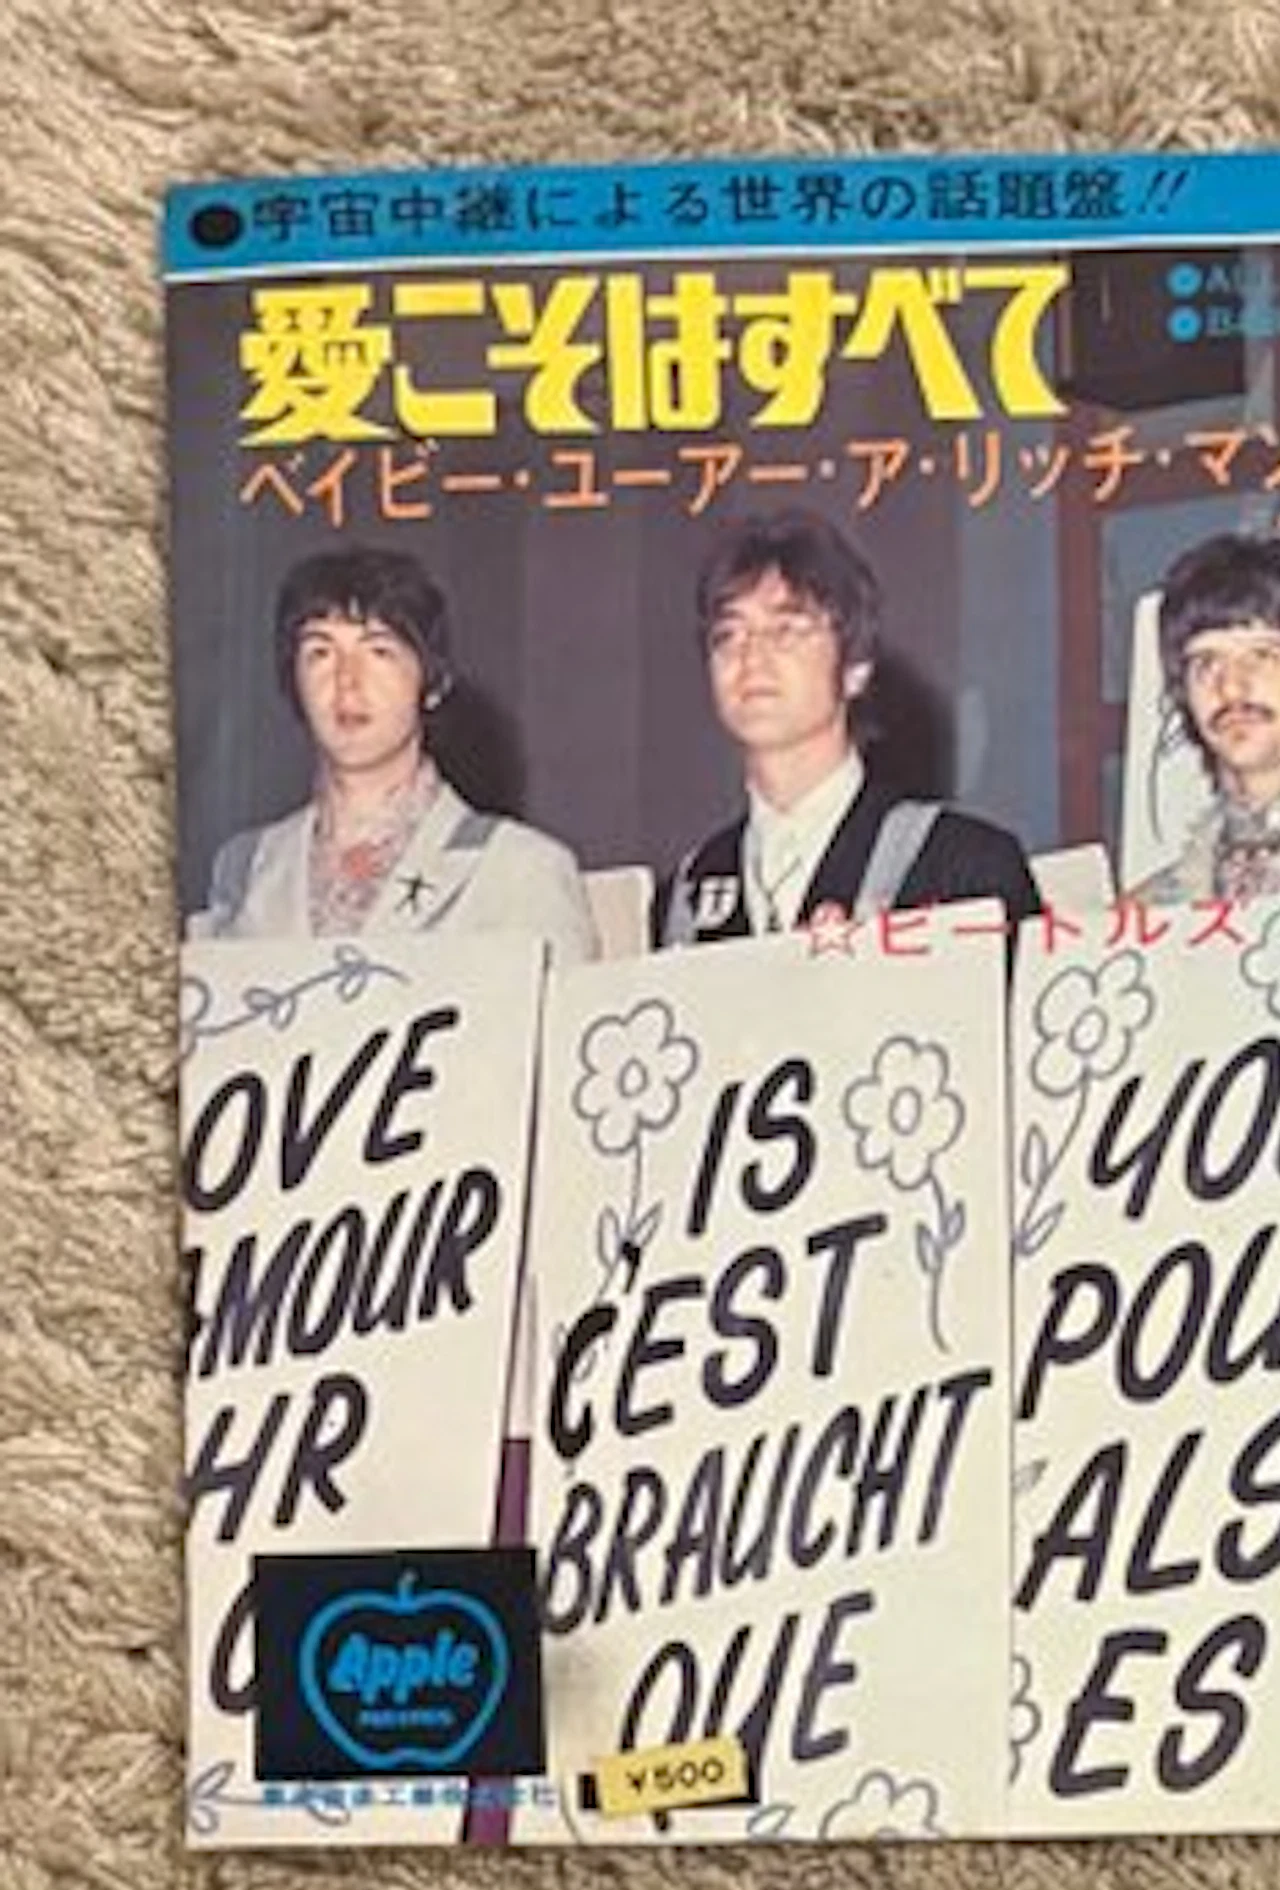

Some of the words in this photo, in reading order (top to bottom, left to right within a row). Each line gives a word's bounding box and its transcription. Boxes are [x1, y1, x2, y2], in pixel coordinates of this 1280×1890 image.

[239, 264, 1072, 446] 愛こそはすべて
[183, 1006, 460, 1214] OVE
[686, 1057, 817, 1236] IS
[541, 1367, 993, 1637] BRAUCHT
[327, 1630, 478, 1704] Apple
[1047, 1612, 1269, 1799] ES
[625, 1756, 725, 1797] ¥500
